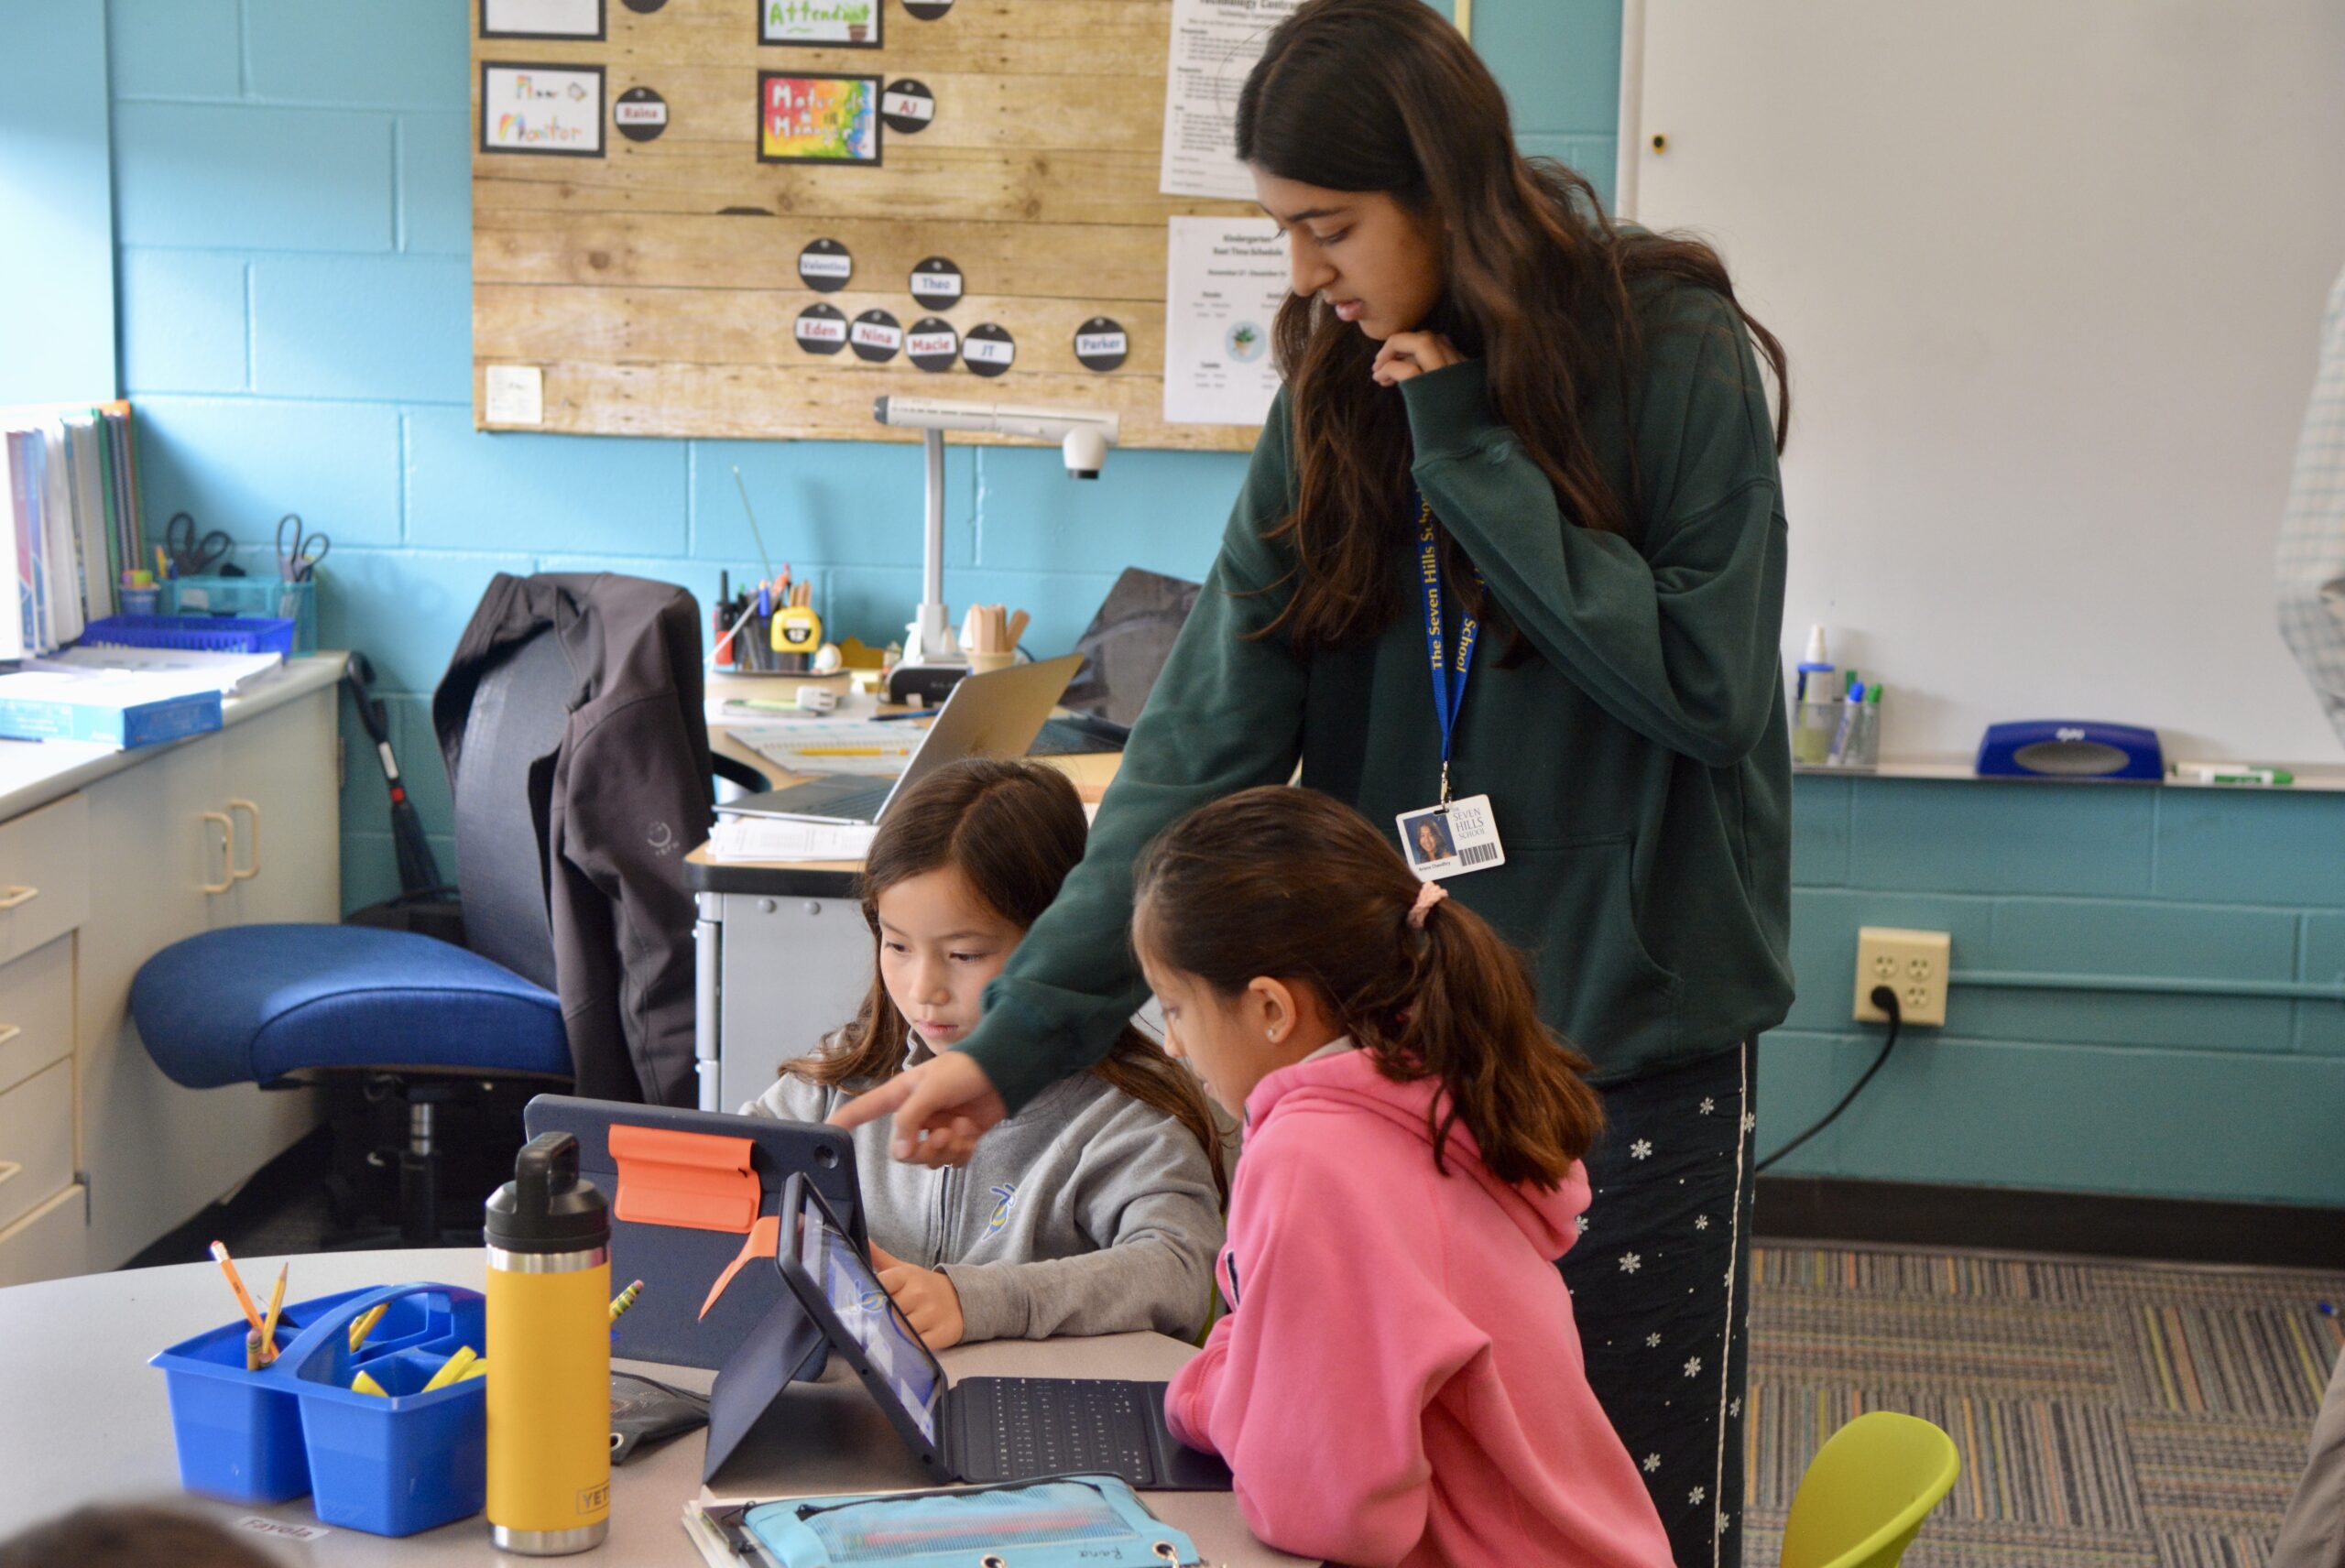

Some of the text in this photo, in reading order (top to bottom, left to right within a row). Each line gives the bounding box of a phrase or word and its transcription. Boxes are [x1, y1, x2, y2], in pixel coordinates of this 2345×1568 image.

[624, 106, 659, 119] Raina
[899, 99, 919, 115] AJ
[922, 277, 951, 290] Theo
[803, 322, 837, 338] Eden
[860, 325, 893, 346] Nina
[911, 336, 951, 353] Macie
[981, 343, 995, 357] JT
[1081, 336, 1122, 351] Parker
[1418, 497, 1443, 670] The Seven Hills Scho
[1456, 618, 1476, 672] School
[1454, 808, 1480, 821] SEVEN
[1456, 817, 1484, 832] HILLS
[1458, 828, 1486, 839] SCHOOL
[582, 1485, 610, 1508] YET
